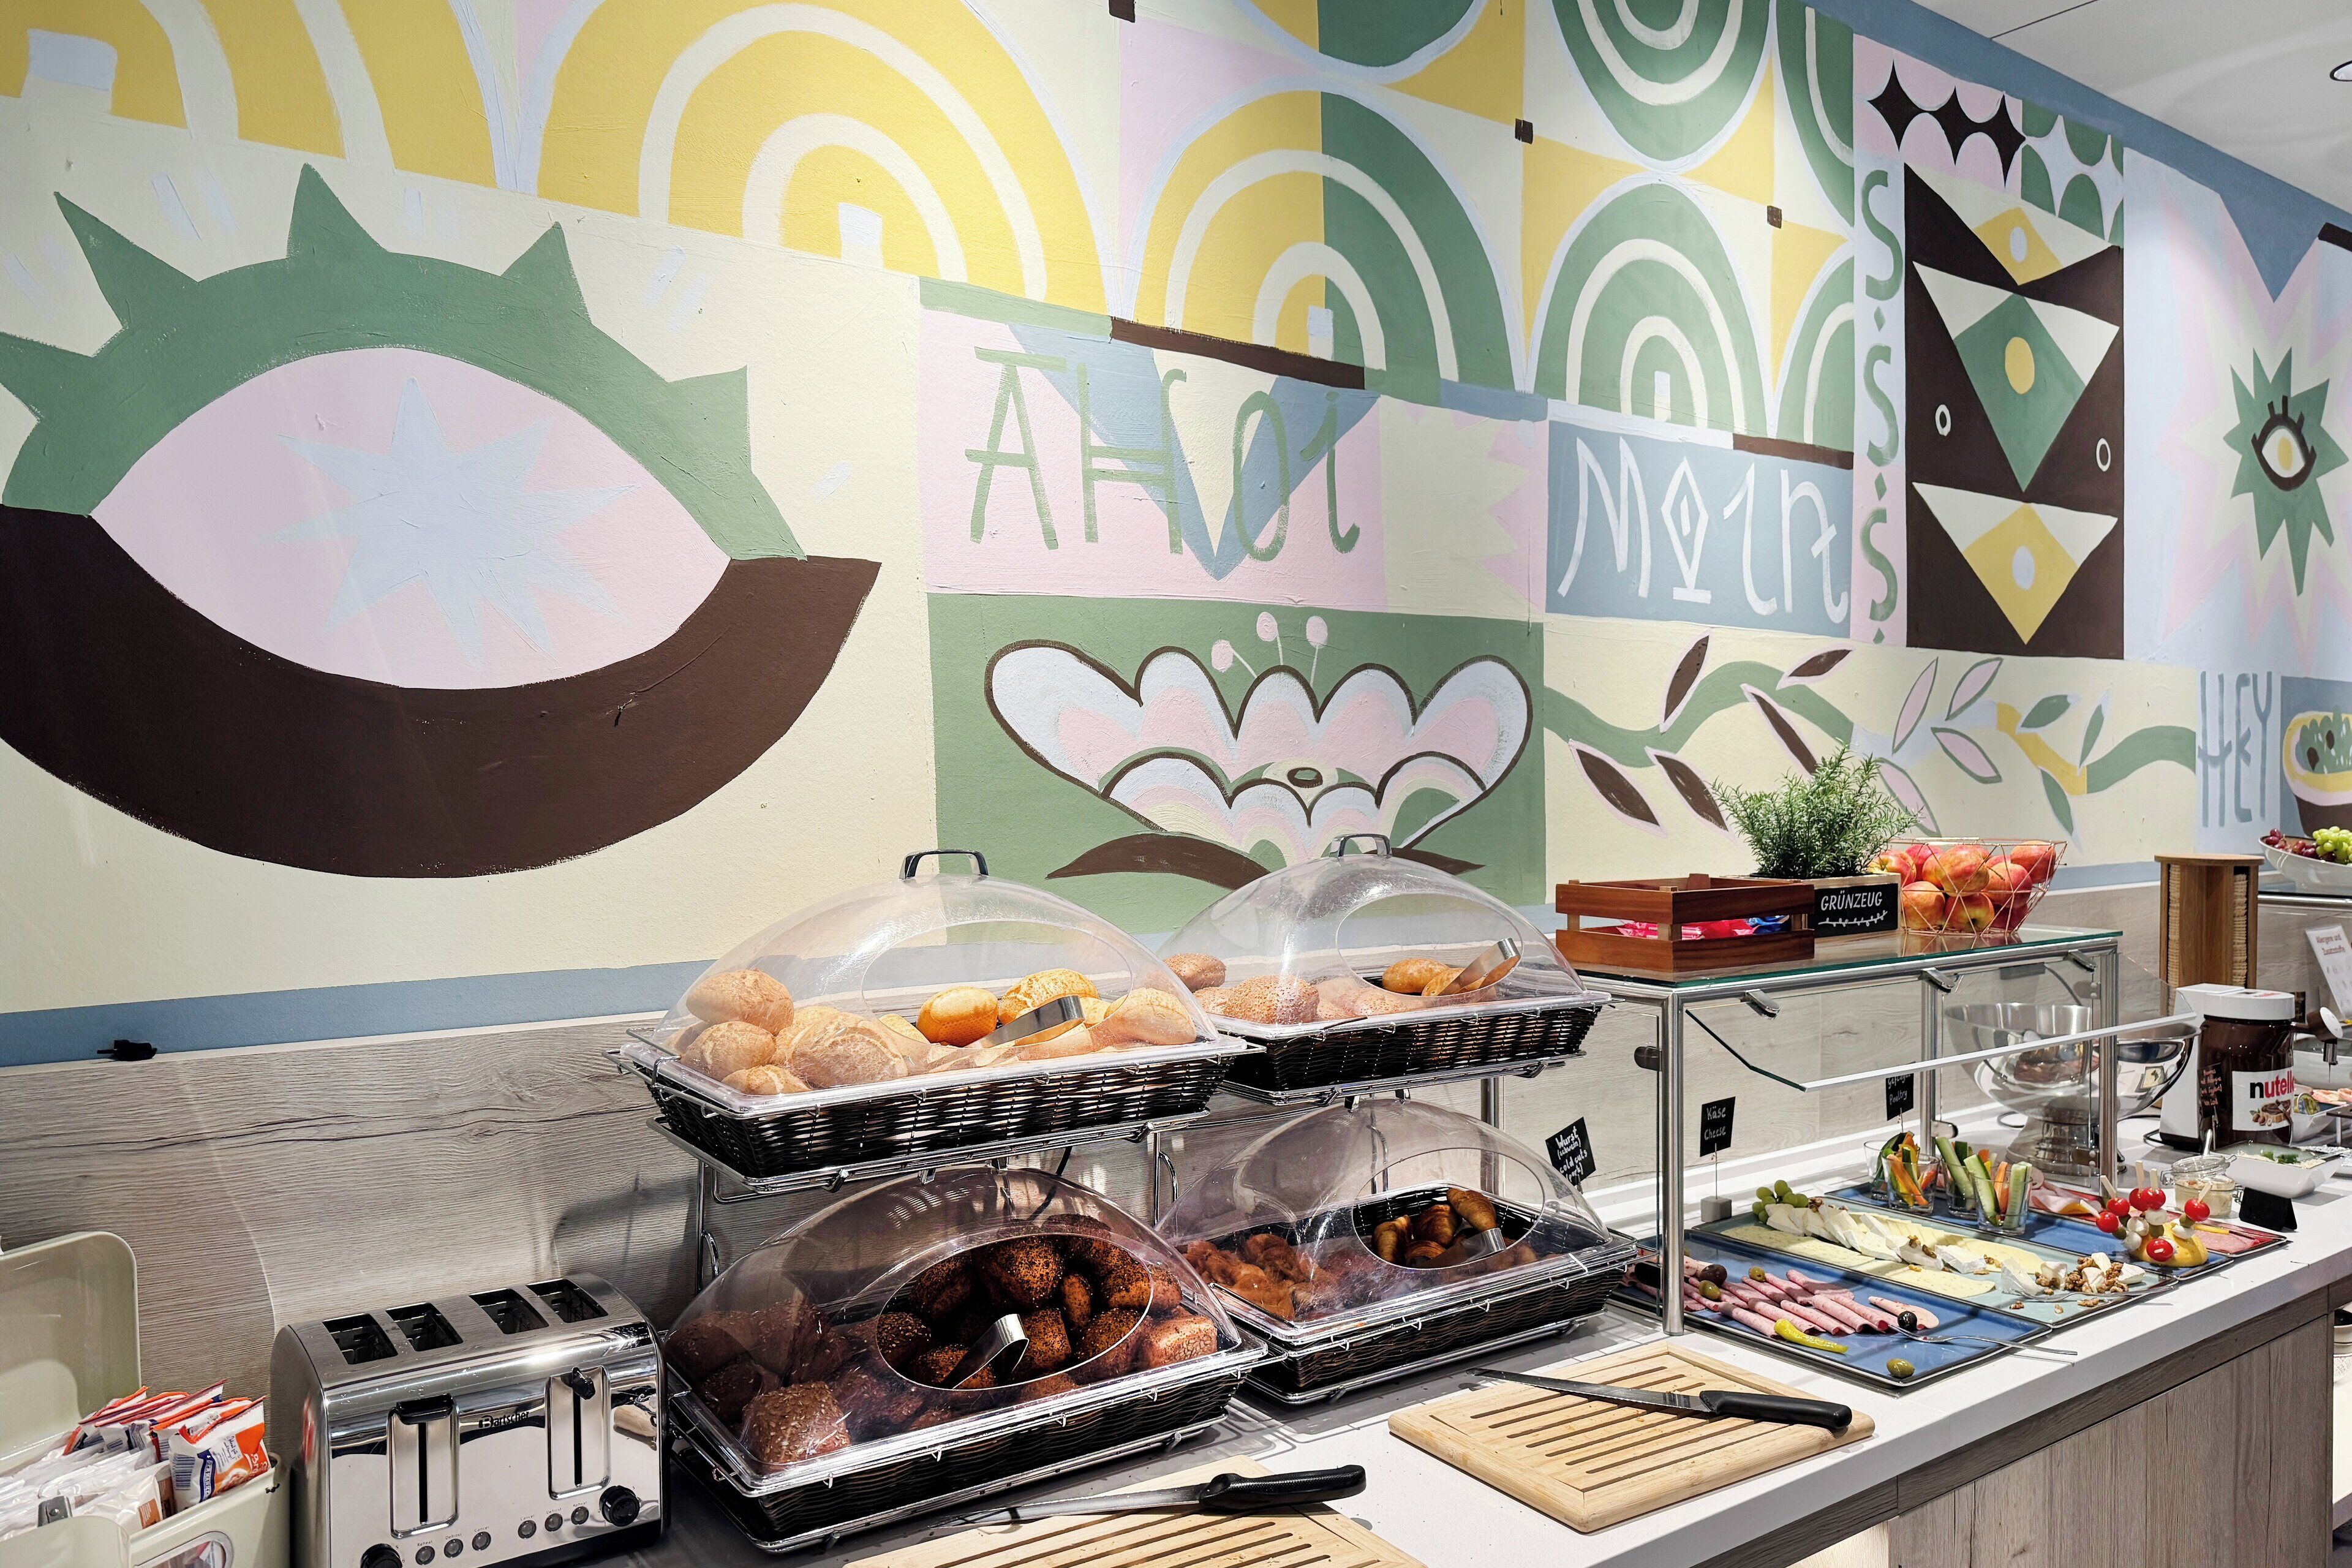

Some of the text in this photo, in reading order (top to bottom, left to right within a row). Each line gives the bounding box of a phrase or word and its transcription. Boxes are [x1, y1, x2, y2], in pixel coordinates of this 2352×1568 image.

[2198, 671, 2272, 827] HEY
[1820, 890, 1883, 911] GRÜNZEUG
[1889, 1090, 1907, 1106] Poultry
[1706, 1106, 1726, 1120] Käse
[1555, 1126, 1578, 1149] Wurst
[1704, 1126, 1726, 1140] Cheese
[1559, 1148, 1588, 1174] cold cuts
[478, 1411, 530, 1428] Bartscher
